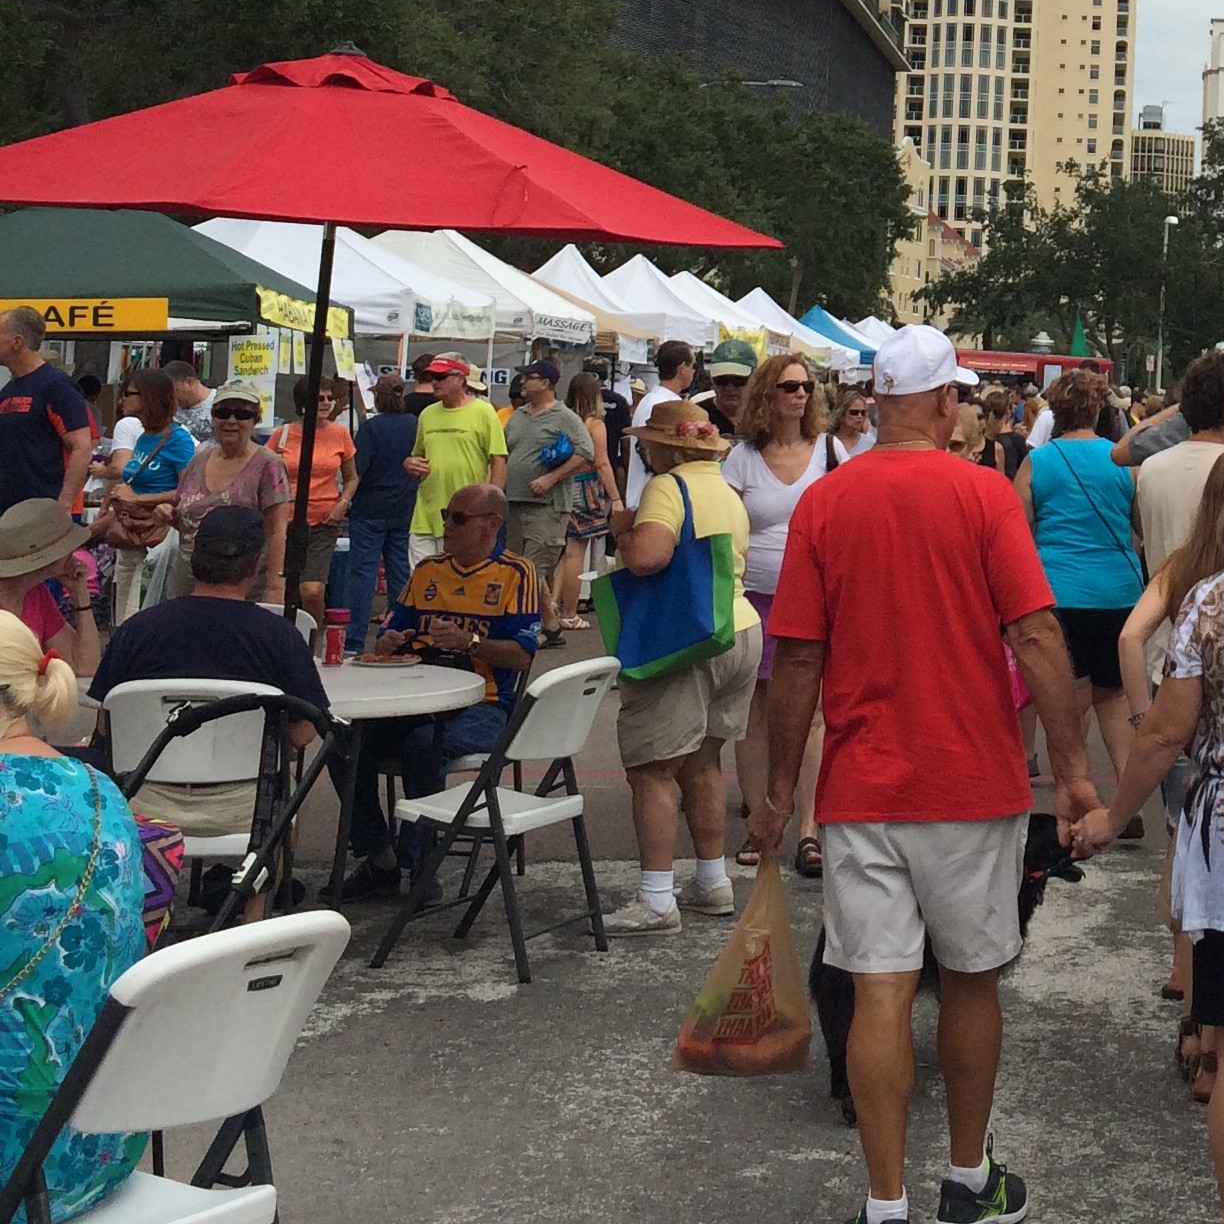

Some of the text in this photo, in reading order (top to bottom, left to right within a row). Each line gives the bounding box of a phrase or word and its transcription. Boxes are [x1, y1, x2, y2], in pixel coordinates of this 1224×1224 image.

[19, 301, 115, 327] AFÉ
[535, 315, 587, 332] MASSAGE
[231, 339, 275, 352] Hot Pressed
[239, 352, 263, 364] Cuban
[234, 364, 269, 376] Sandwich
[420, 615, 491, 638] TIRES
